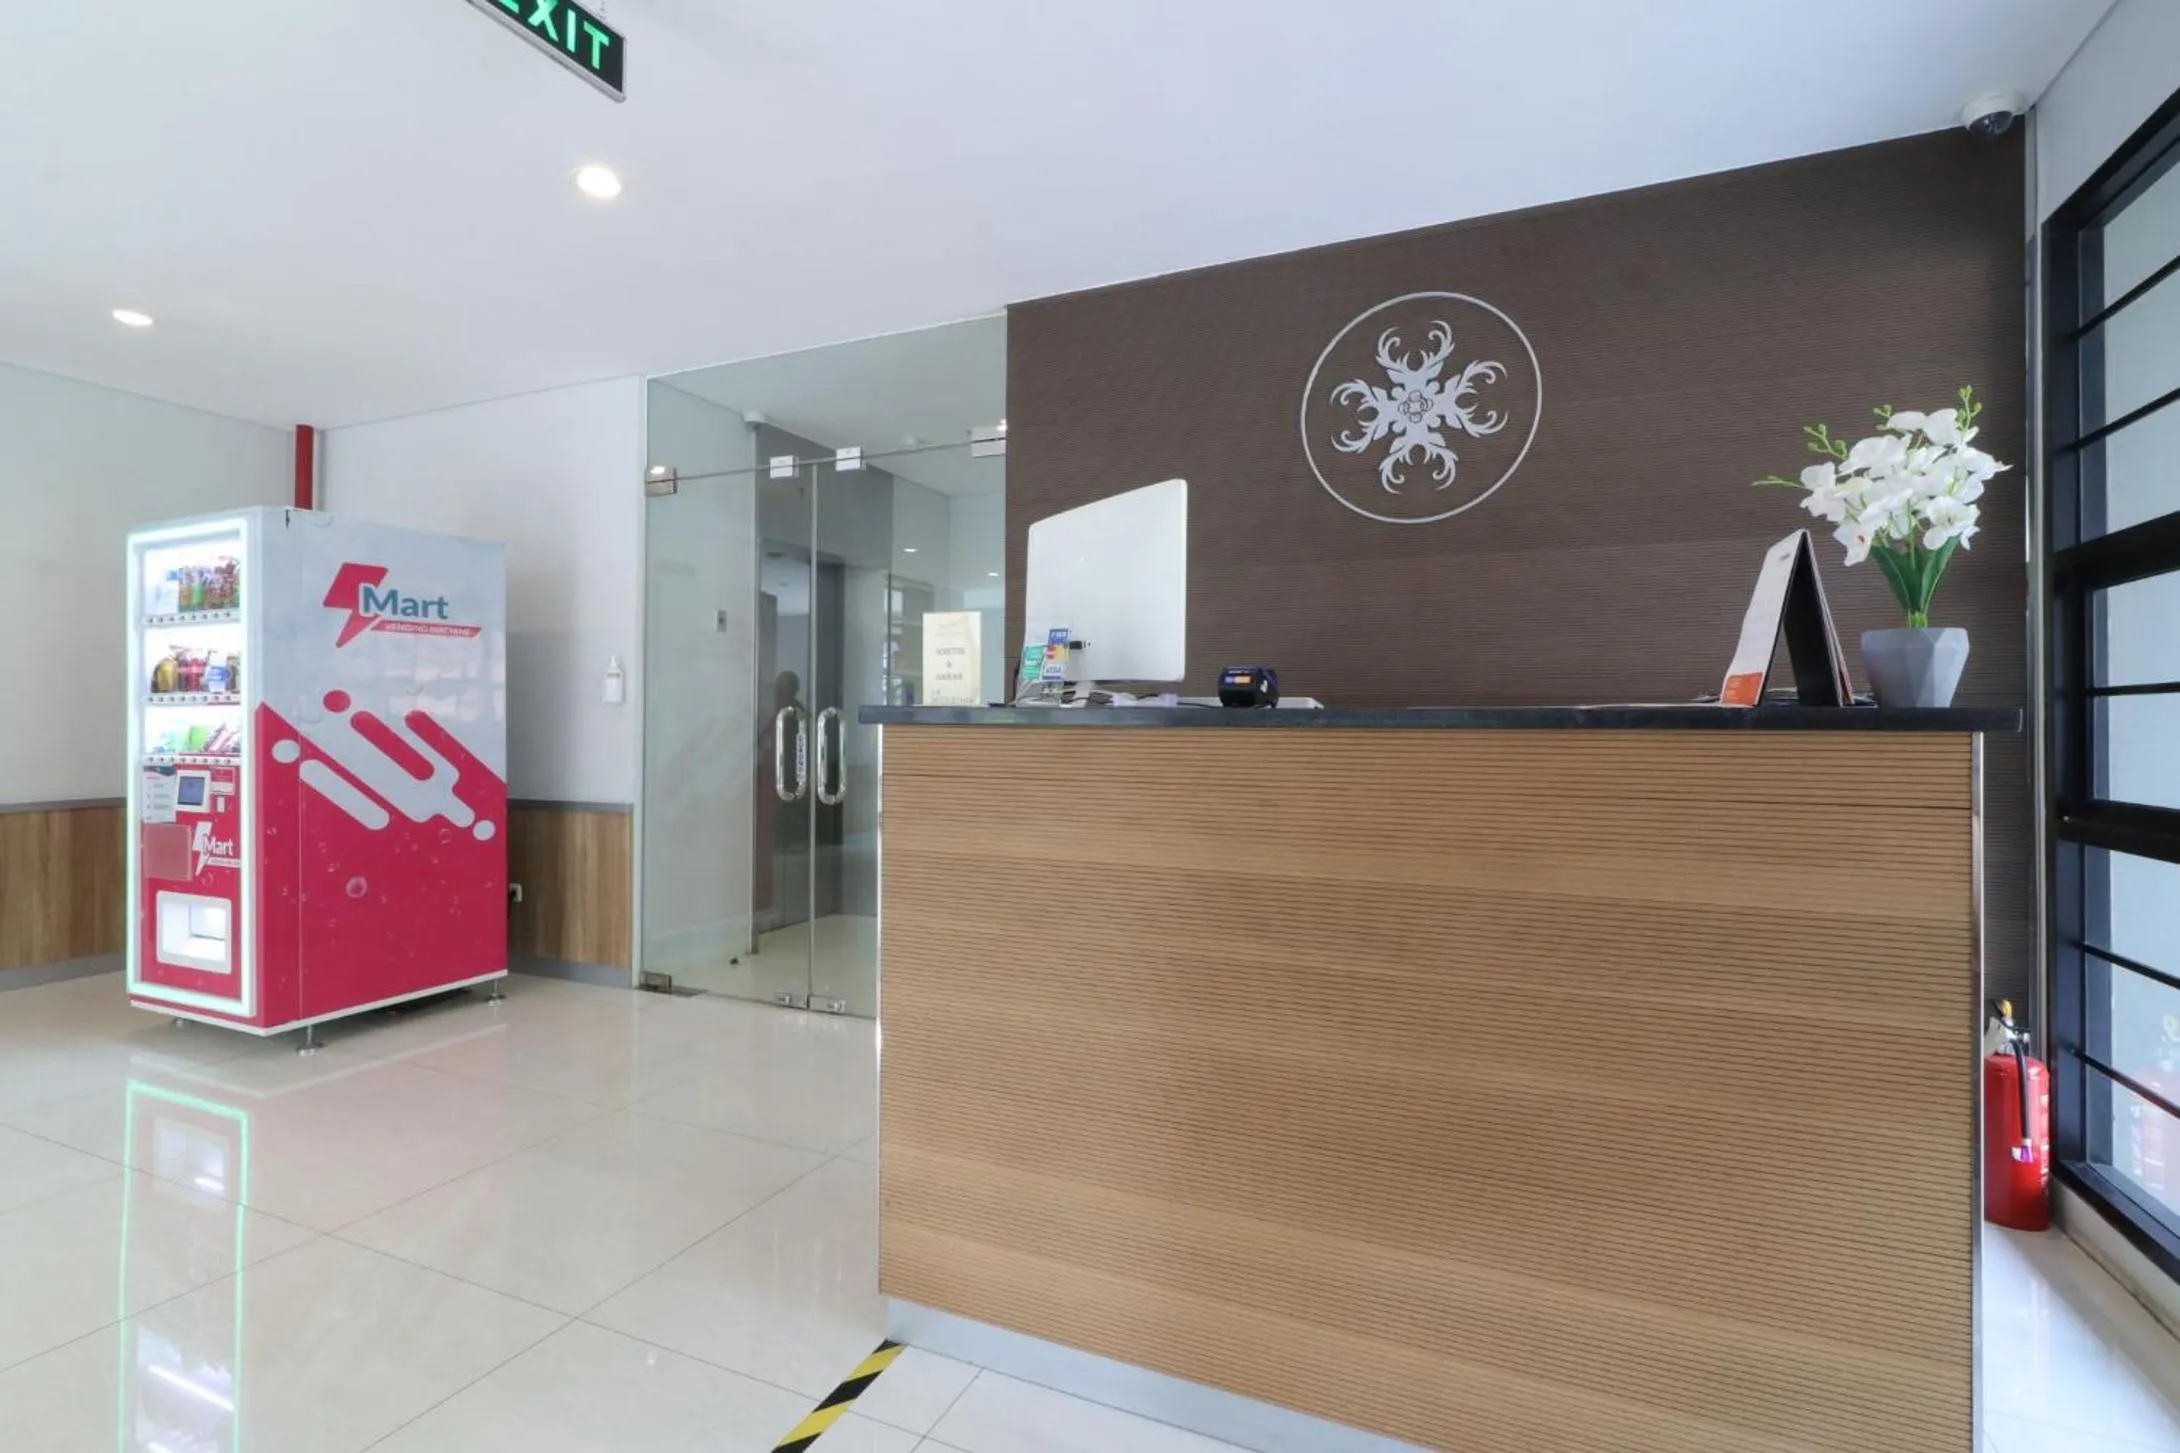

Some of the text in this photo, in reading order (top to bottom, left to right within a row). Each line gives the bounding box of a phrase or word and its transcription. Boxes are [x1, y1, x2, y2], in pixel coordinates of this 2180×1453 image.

[497, 0, 610, 70] XIT
[363, 587, 448, 619] Mart
[203, 836, 234, 856] Mart
